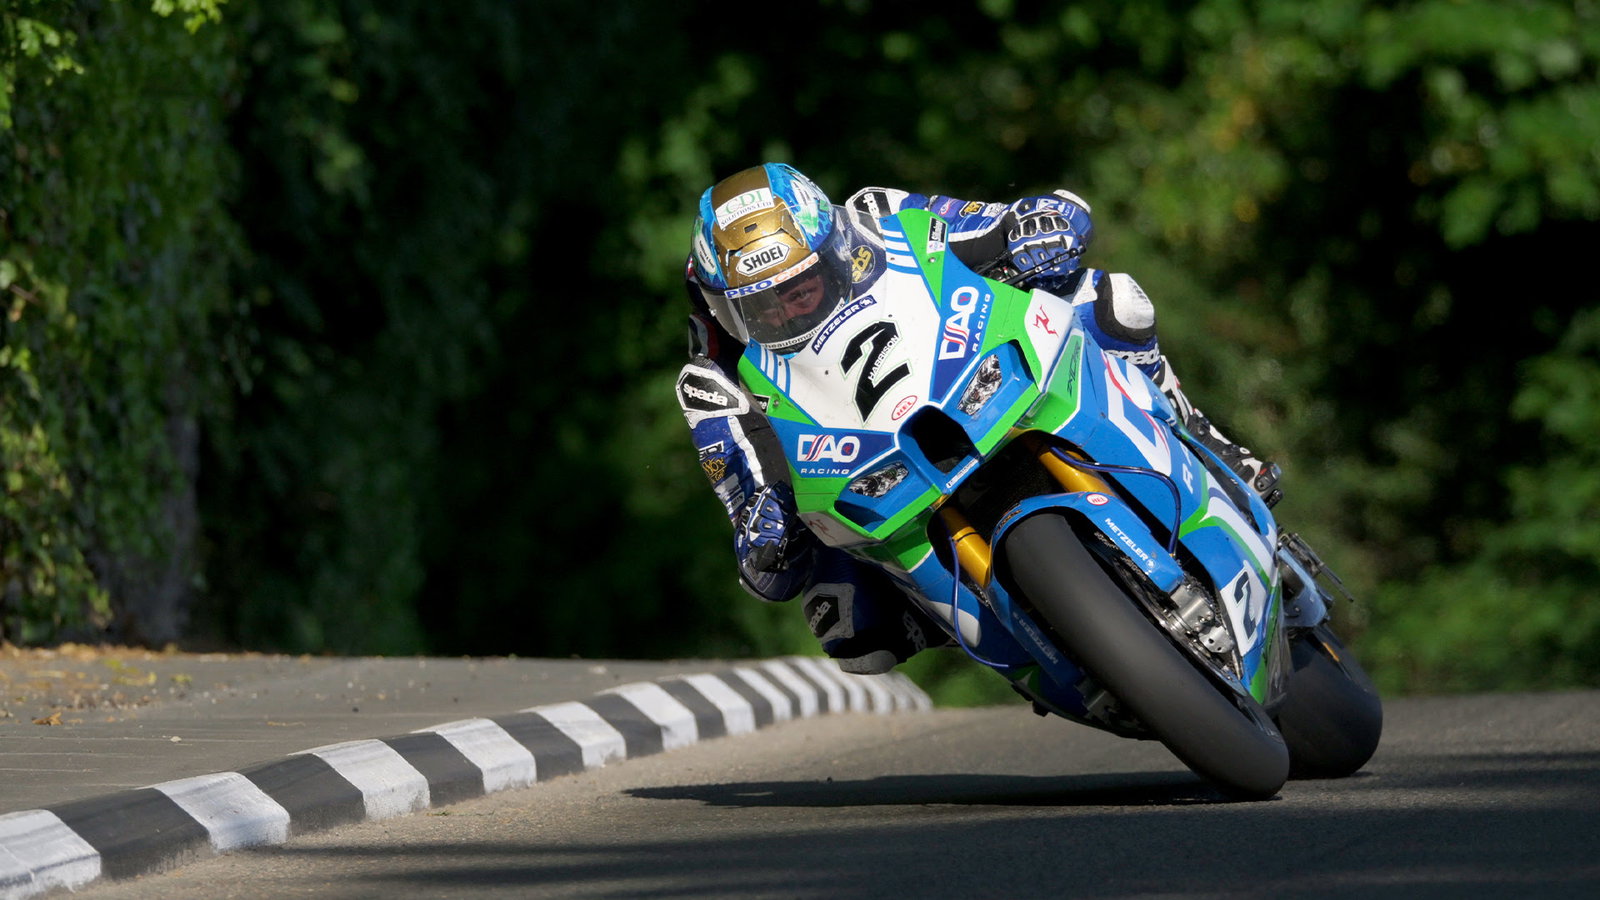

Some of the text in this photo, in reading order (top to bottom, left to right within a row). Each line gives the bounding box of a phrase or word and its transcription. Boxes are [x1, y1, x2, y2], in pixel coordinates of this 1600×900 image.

[726, 190, 763, 214] CDI
[743, 245, 784, 272] SHOEI
[813, 304, 860, 351] METZELER
[938, 286, 980, 361] DAO
[972, 293, 991, 352] RACING
[840, 321, 911, 423] 2
[867, 334, 899, 381] HARRISON
[683, 383, 728, 406] spada
[896, 398, 914, 417] HEL
[797, 434, 860, 463] DAO
[1104, 517, 1149, 562] METZELER
[1233, 571, 1257, 640] 2
